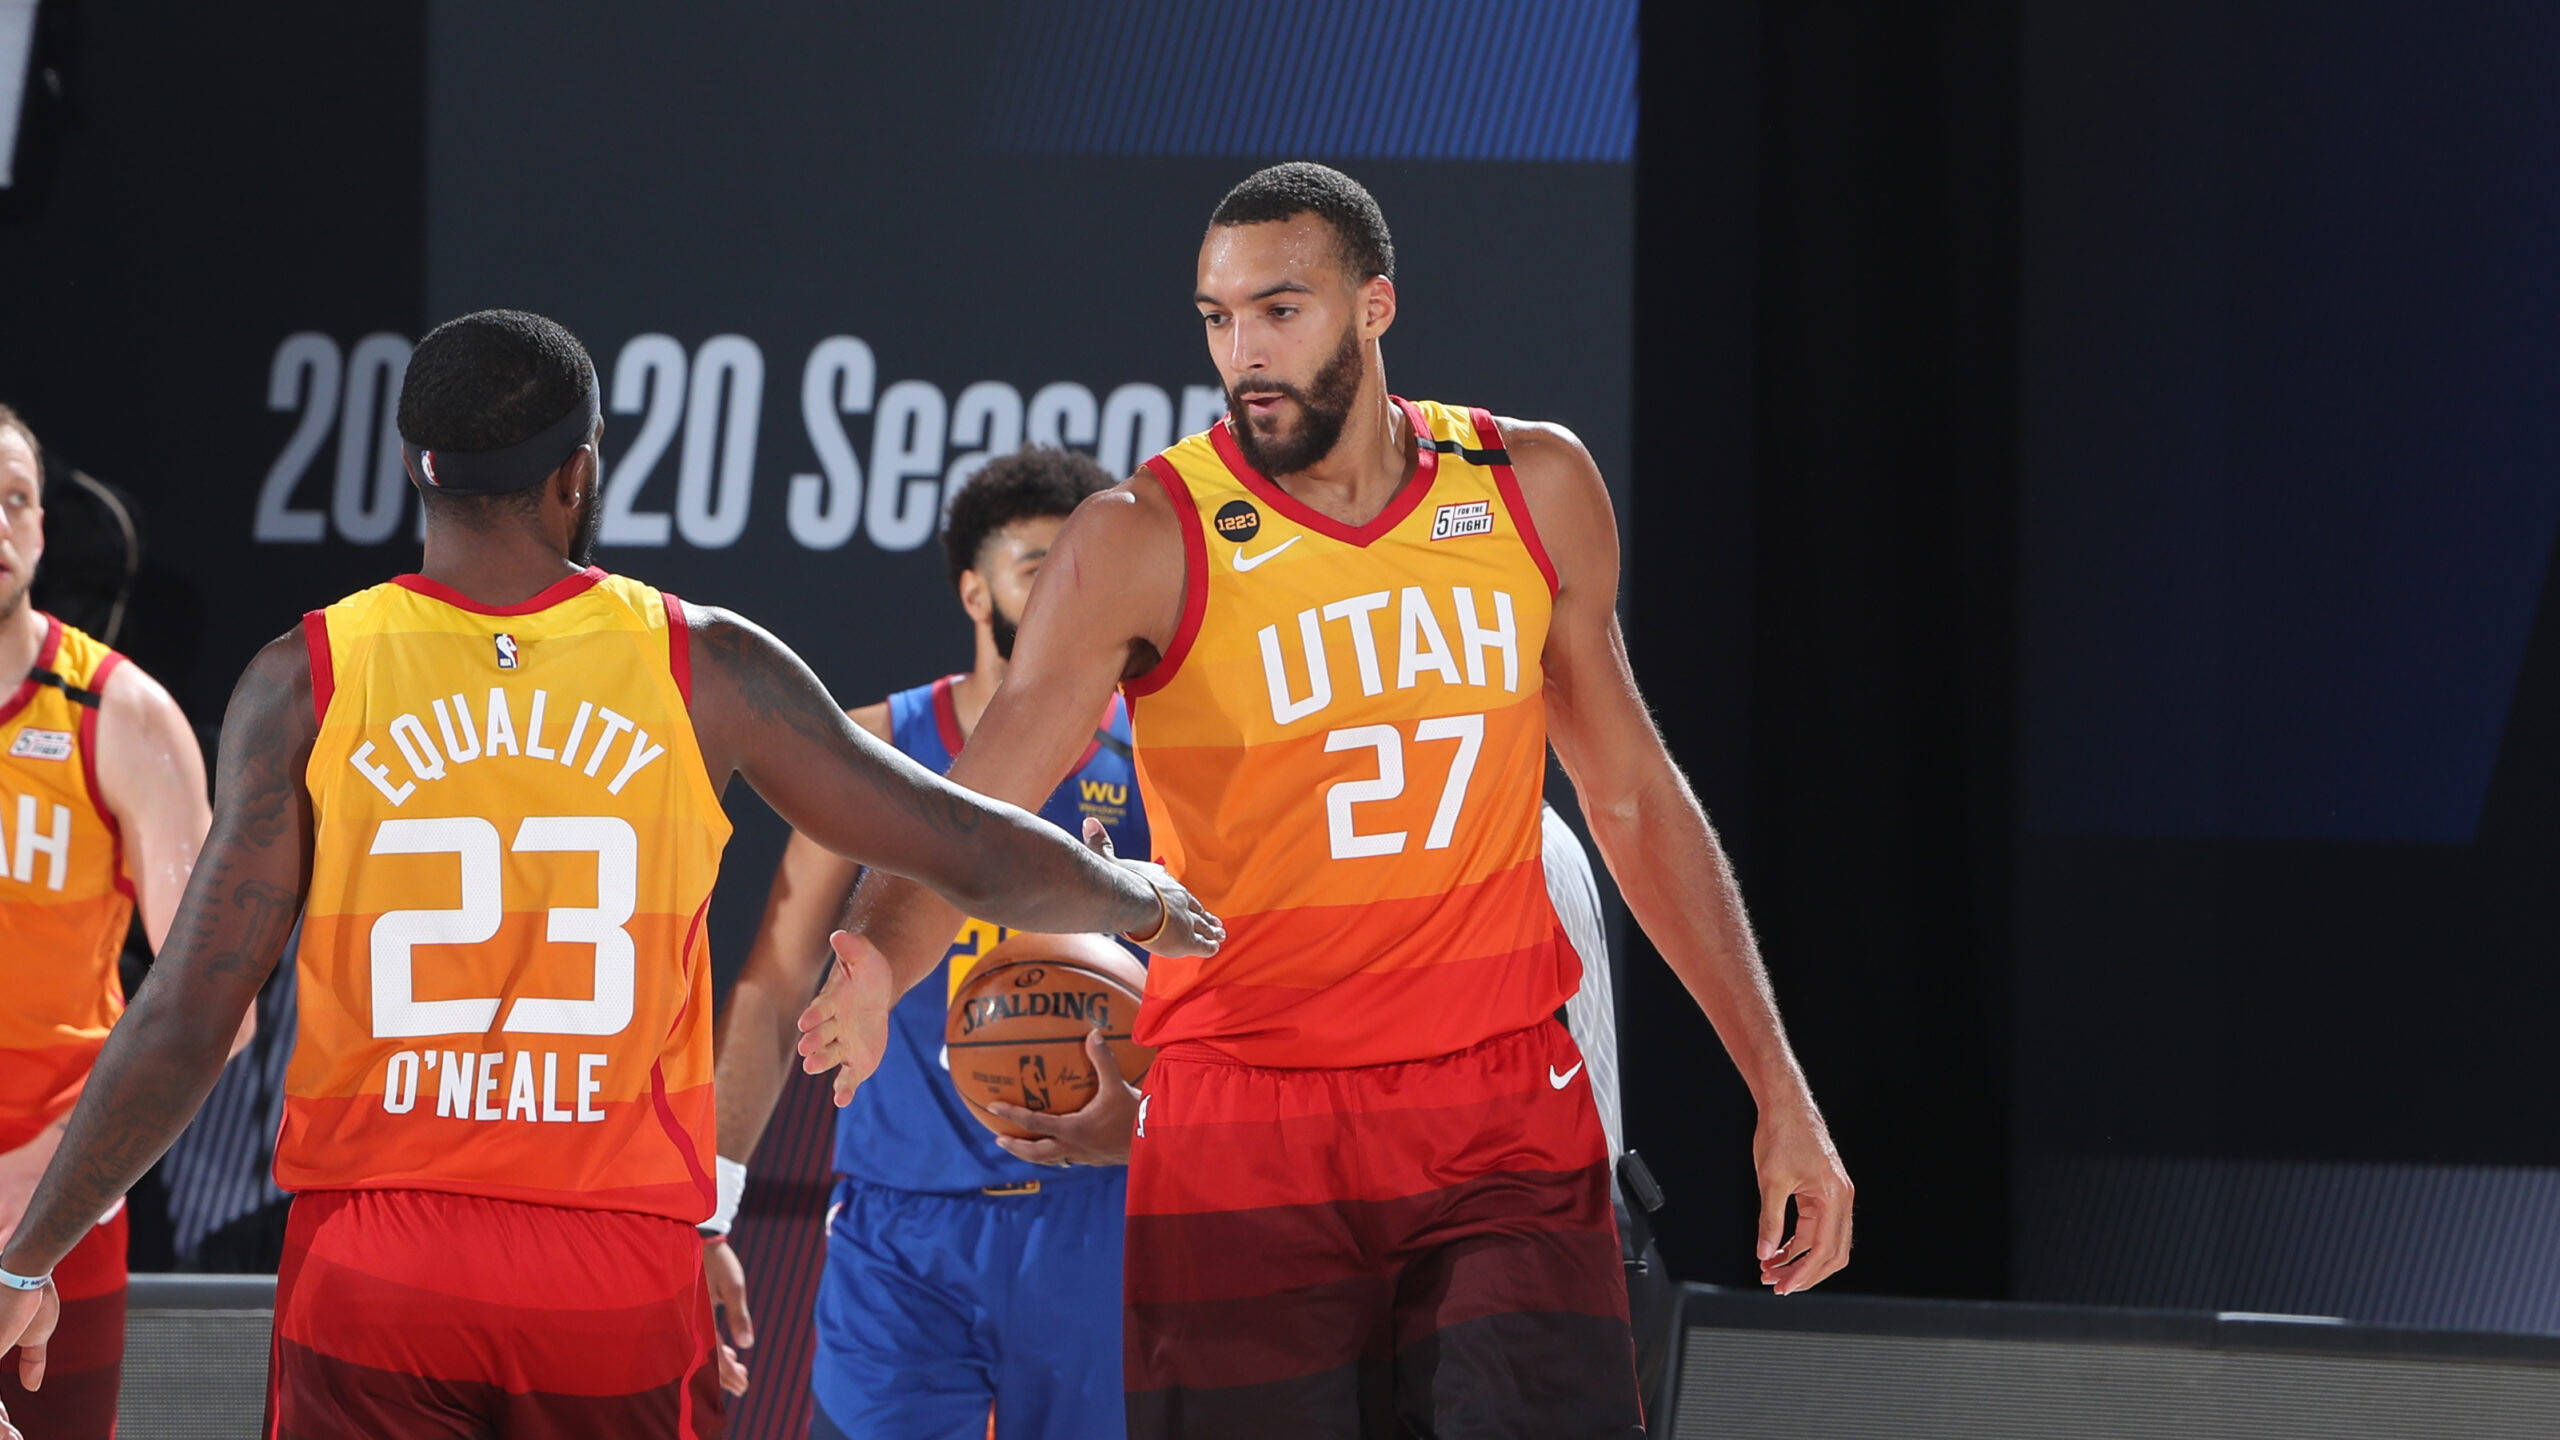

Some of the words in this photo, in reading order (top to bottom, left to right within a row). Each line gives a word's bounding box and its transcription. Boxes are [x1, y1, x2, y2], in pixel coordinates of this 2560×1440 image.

[254, 332, 765, 549] 2020
[786, 334, 1227, 552] Seao
[1217, 512, 1257, 531] 1223
[1436, 509, 1450, 535] 5
[1455, 518, 1489, 532] FIGHT
[1258, 586, 1519, 726] UTAH
[349, 687, 665, 808] EQUALITY
[1080, 779, 1128, 805] WU
[1324, 714, 1485, 860] 27
[369, 816, 638, 1038] 23
[962, 991, 1110, 1036] SPALDING
[383, 1050, 607, 1122] O'NEALE
